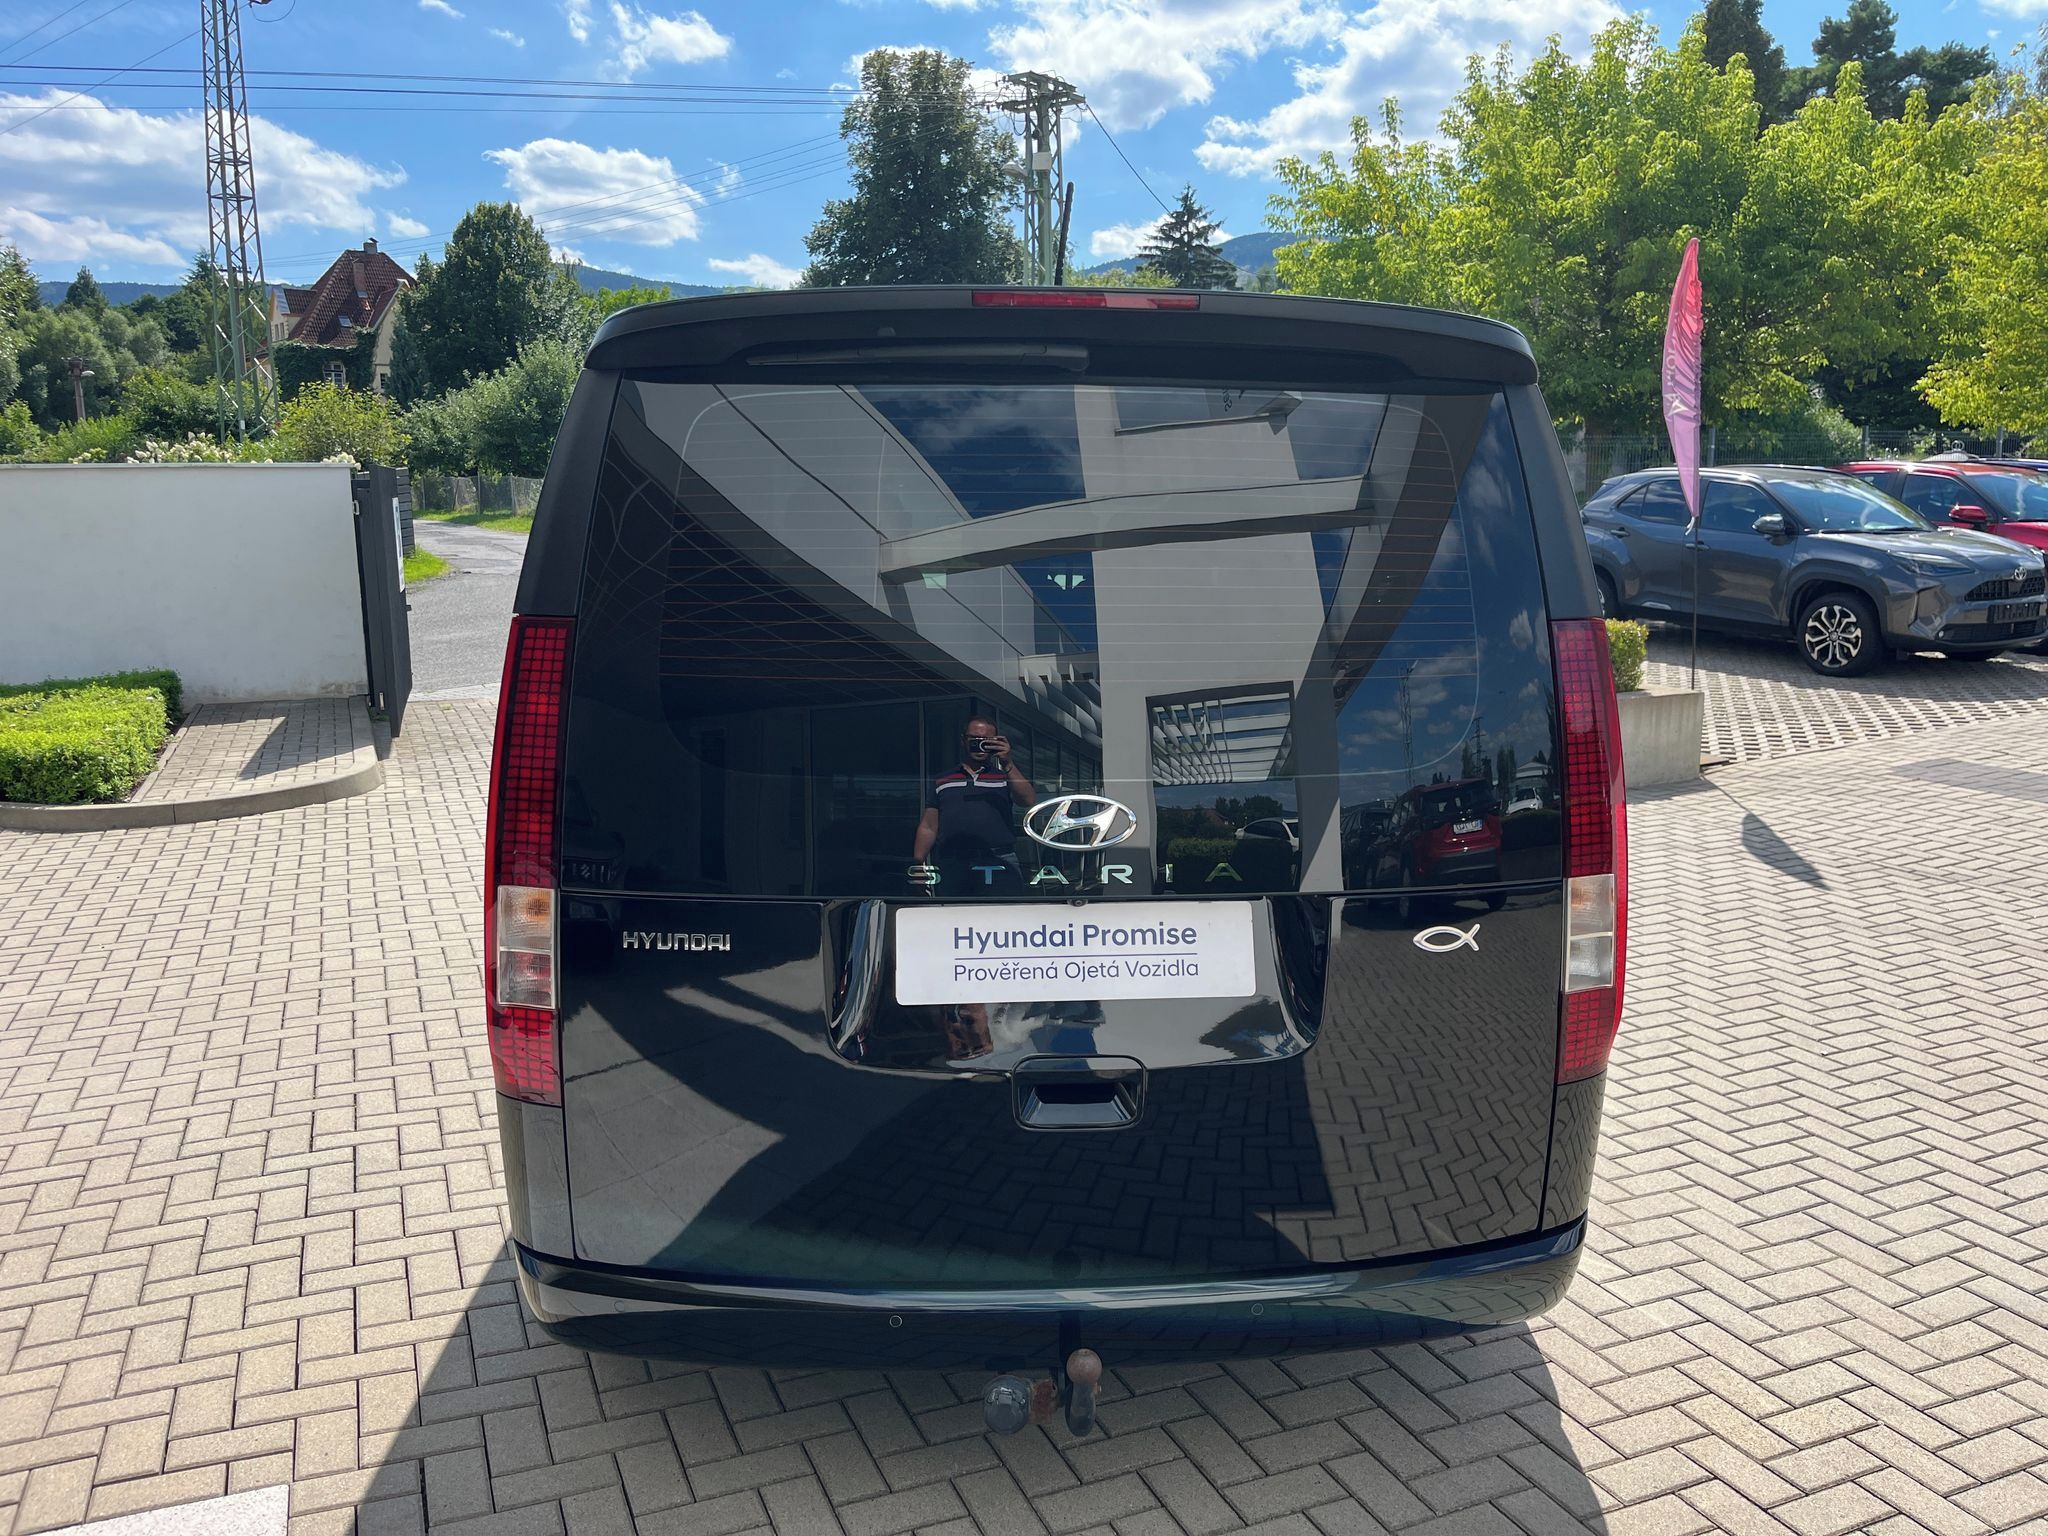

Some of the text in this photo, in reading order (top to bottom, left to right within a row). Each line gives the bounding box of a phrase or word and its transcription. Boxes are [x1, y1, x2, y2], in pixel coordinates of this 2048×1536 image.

[907, 862, 1243, 886] STARIA
[622, 931, 731, 952] HYUNDAI
[953, 921, 1198, 954] Hyundai Promise
[953, 959, 1200, 983] Prověřená Ojetá Vozidla
